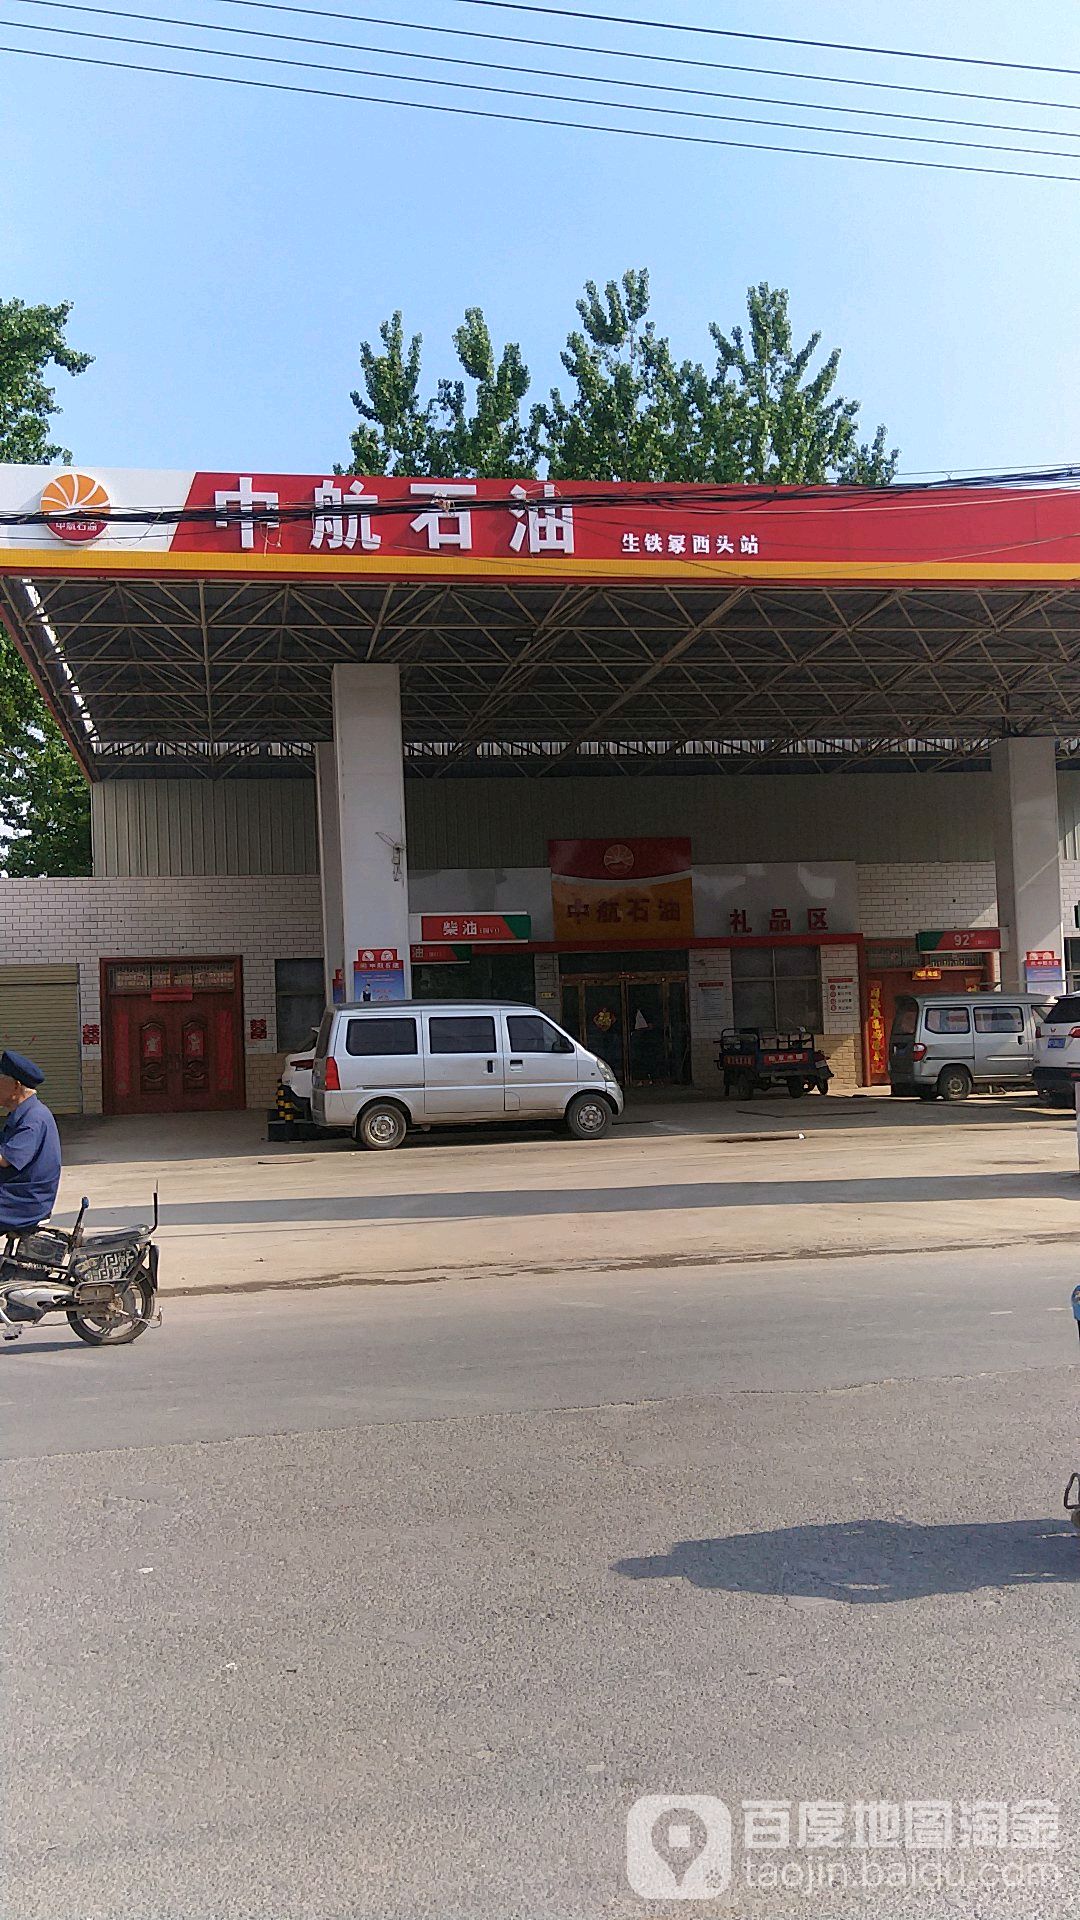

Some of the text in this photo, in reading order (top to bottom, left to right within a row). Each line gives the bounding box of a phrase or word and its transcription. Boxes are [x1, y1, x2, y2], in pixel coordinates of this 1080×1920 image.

[214, 476, 575, 554] 中航石油
[622, 533, 759, 554] 生铁冢西头站
[566, 898, 681, 924] 中航石油
[729, 908, 829, 933] 礼品区
[442, 920, 478, 936] 柴油
